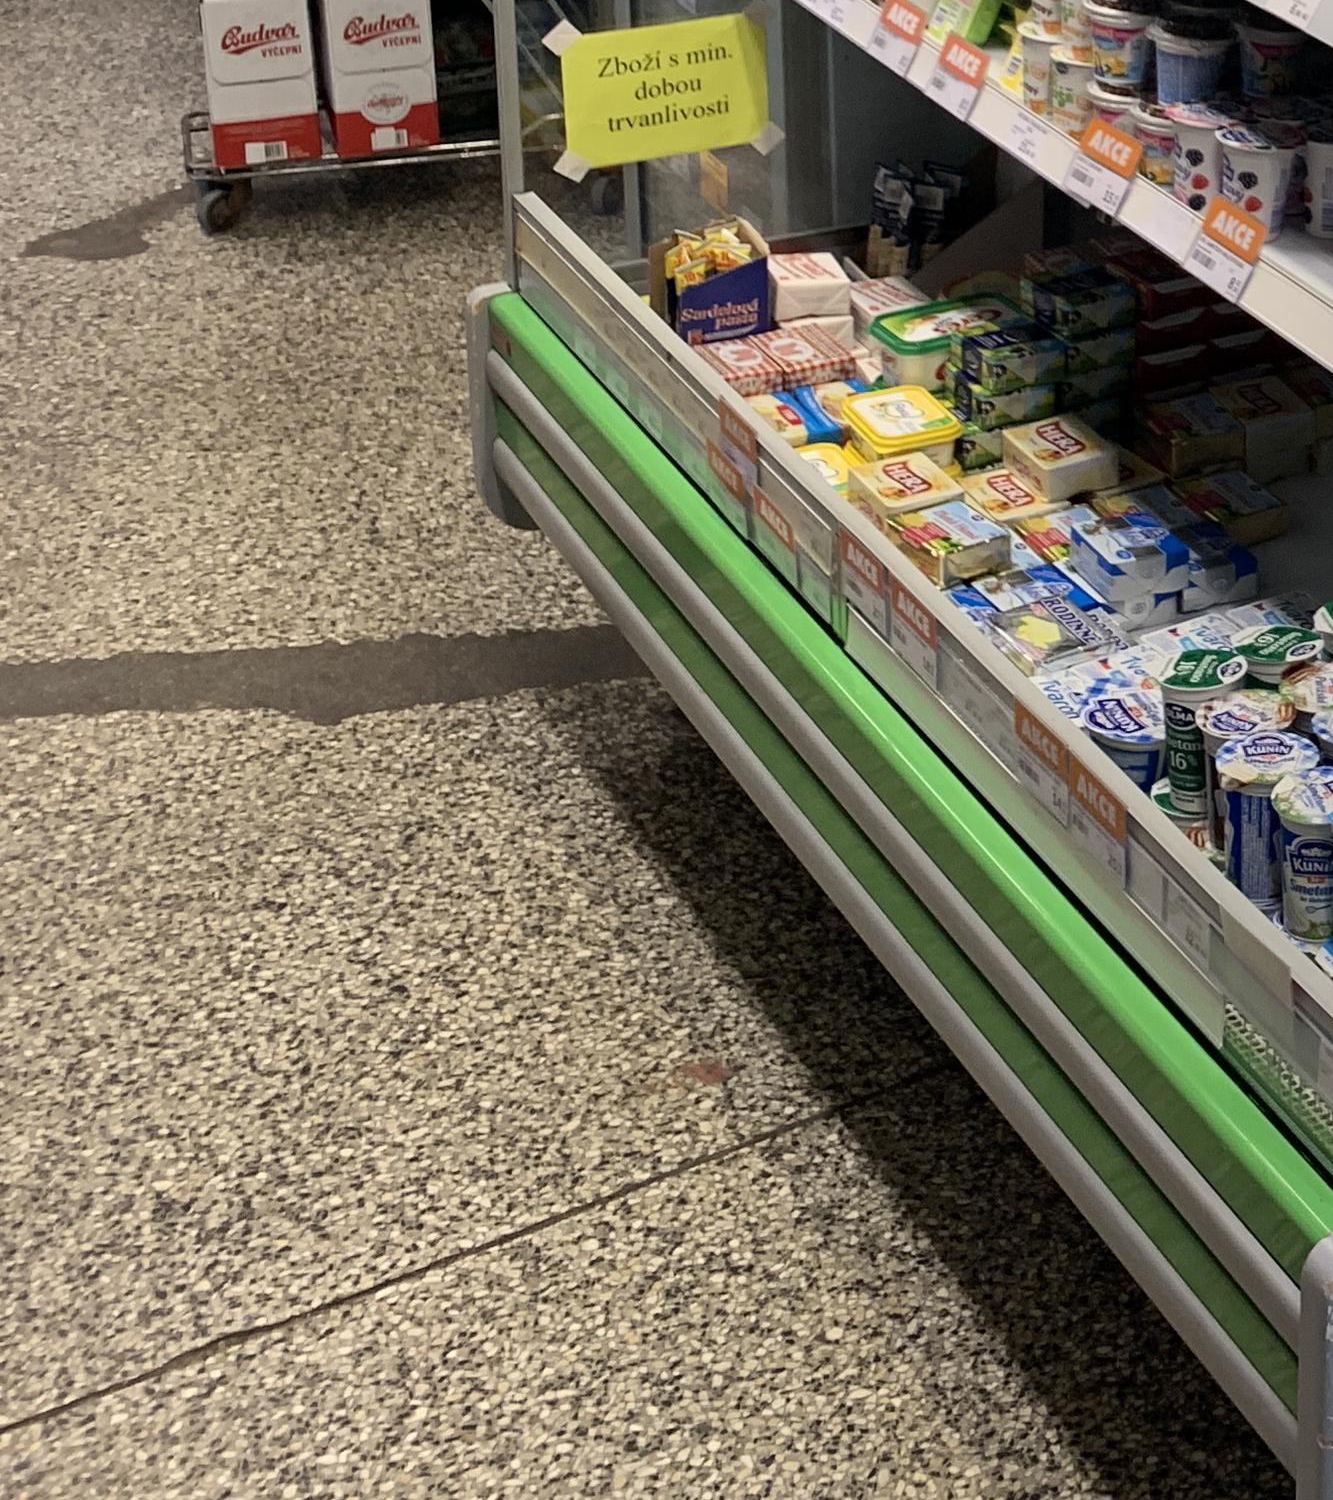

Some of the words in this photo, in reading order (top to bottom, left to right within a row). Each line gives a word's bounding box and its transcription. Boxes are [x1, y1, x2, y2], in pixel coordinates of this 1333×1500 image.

[343, 12, 420, 46] Budvar
[885, 3, 921, 36] AKCE
[220, 21, 301, 56] Budvar
[598, 49, 662, 78] Zboží
[668, 54, 681, 68] s
[686, 42, 734, 66] min.
[634, 73, 702, 101] dobou
[607, 94, 731, 132] trvanlivosti
[1088, 130, 1132, 167] AKCE
[1210, 210, 1256, 248] AKCE
[1038, 423, 1082, 457] HERA
[885, 463, 929, 494] HERA
[990, 474, 1035, 508] HERA
[1021, 715, 1060, 765] AKCE
